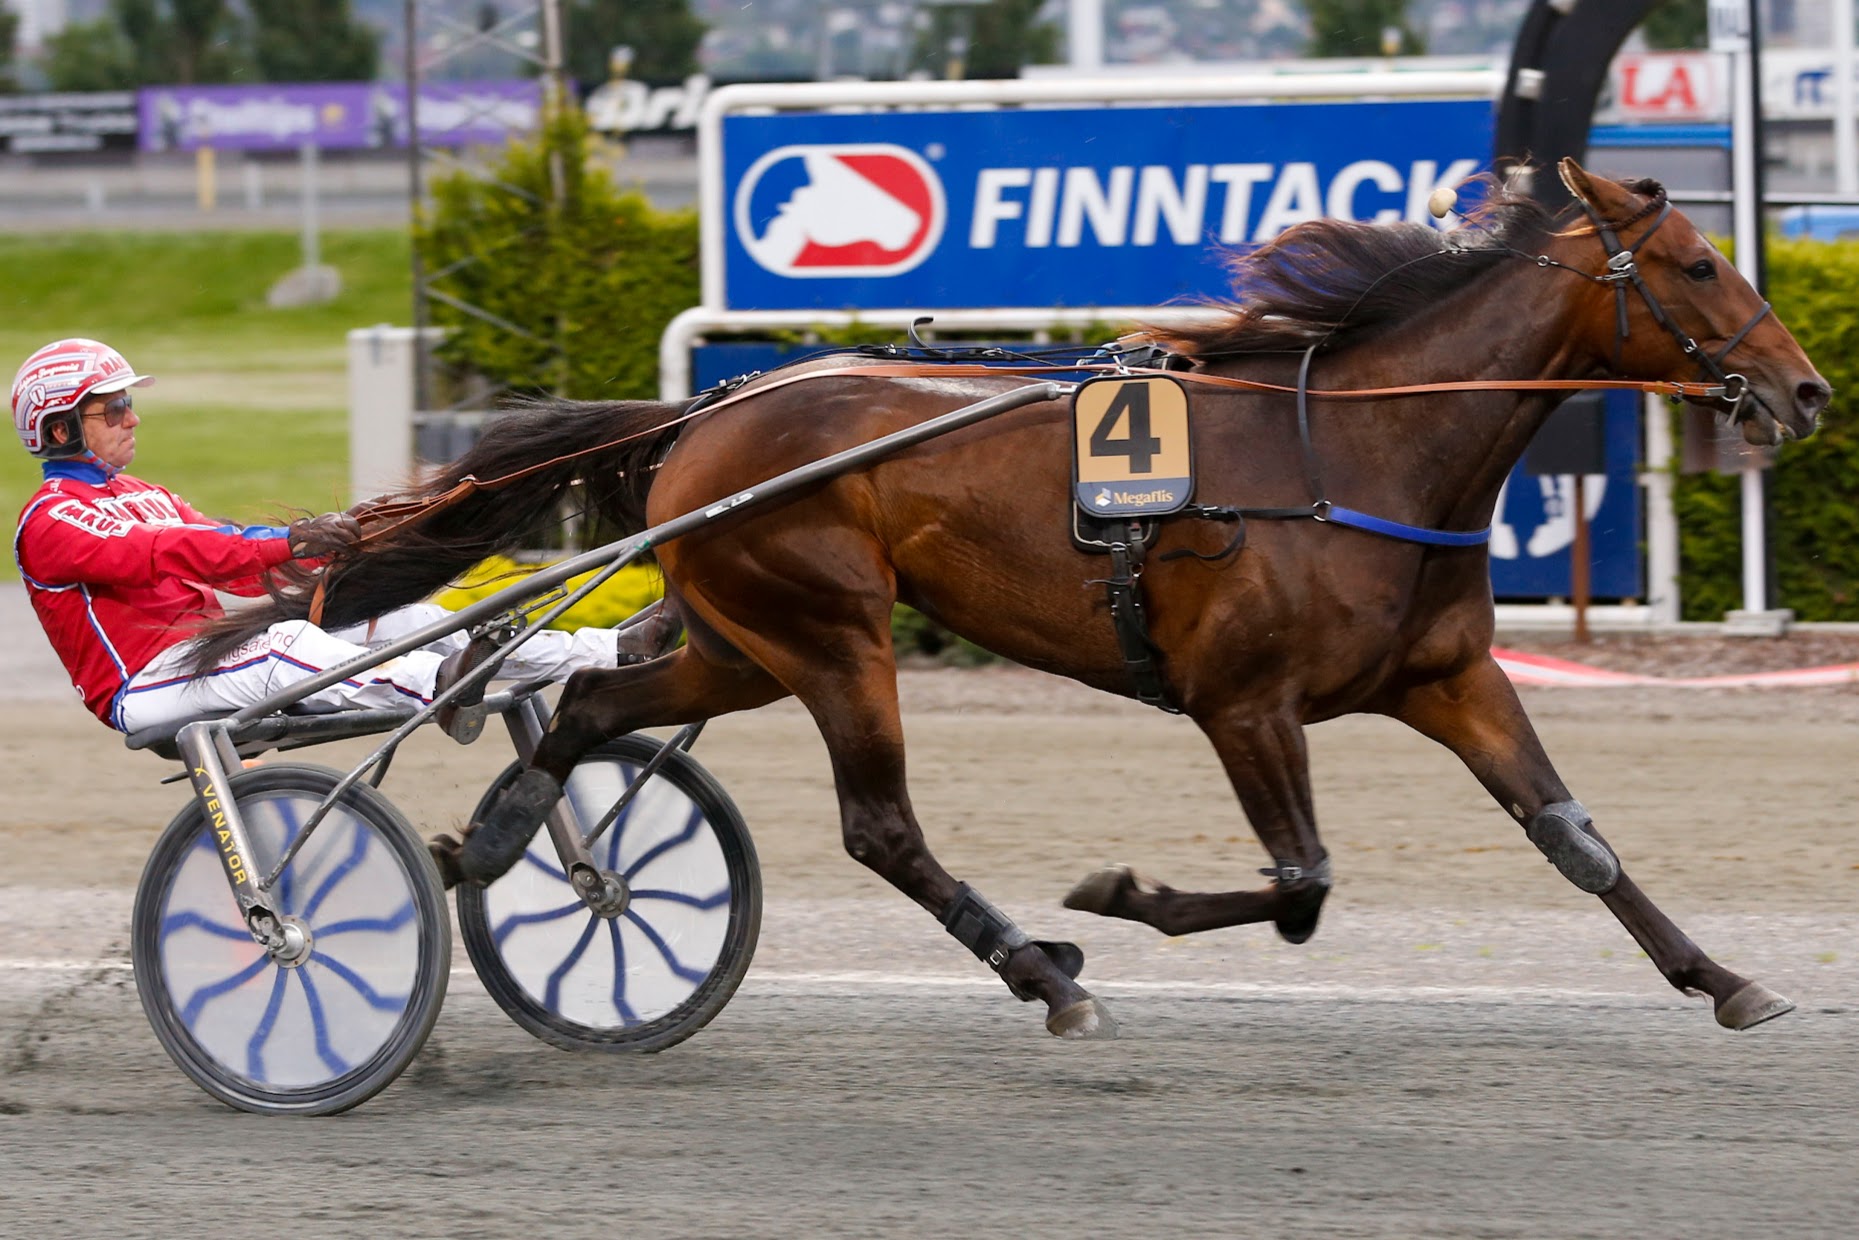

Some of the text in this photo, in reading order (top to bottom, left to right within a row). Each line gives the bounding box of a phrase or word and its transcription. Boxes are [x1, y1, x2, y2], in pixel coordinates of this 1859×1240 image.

[969, 159, 1478, 249] FINNTACK
[1090, 382, 1161, 474] 4
[1114, 489, 1174, 506] Megaflis
[330, 641, 393, 671] VENATOR
[202, 783, 247, 886] VENATOR
